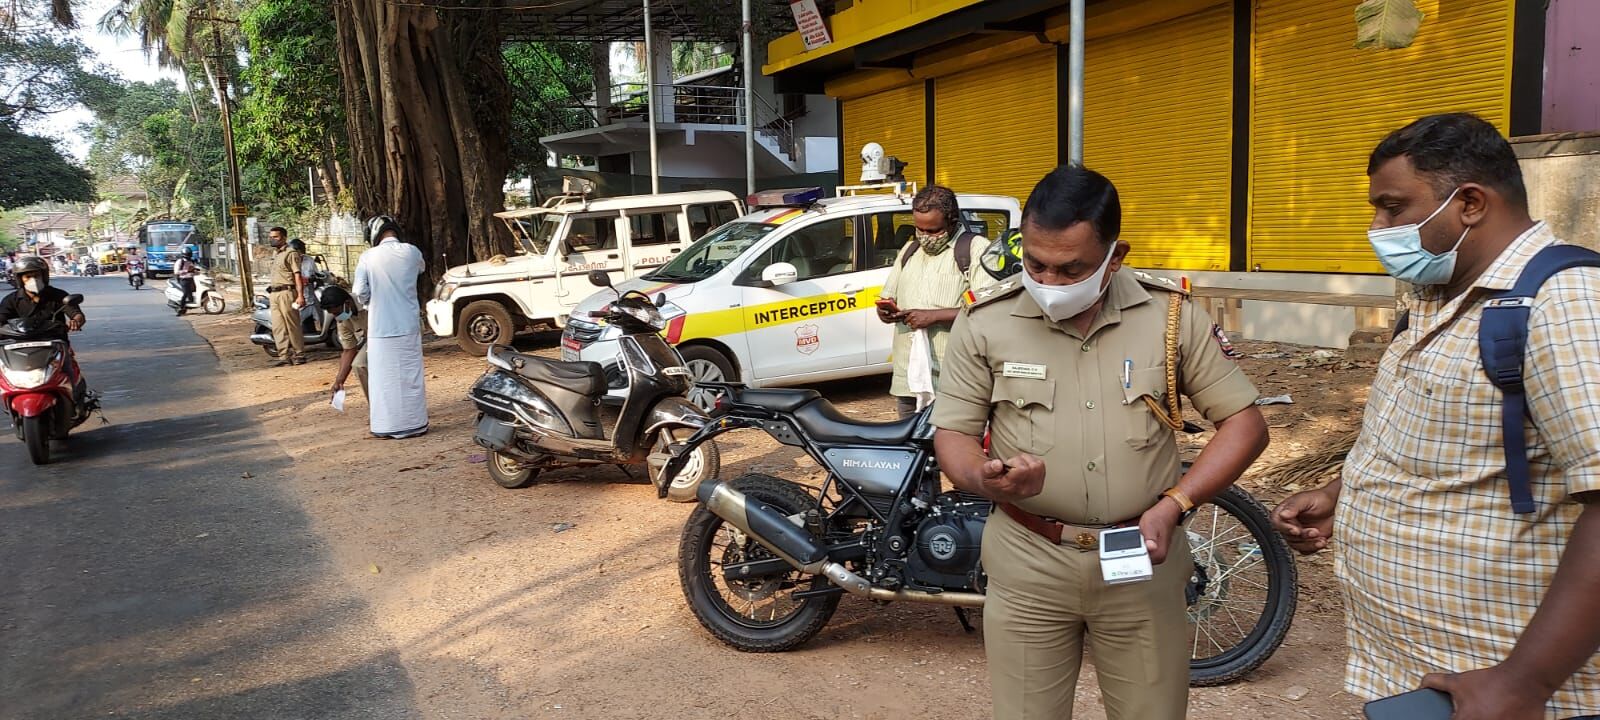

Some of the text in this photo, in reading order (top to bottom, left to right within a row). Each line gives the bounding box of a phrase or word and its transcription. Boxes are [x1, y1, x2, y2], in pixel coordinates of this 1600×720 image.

[642, 254, 675, 264] POLIC
[754, 297, 857, 325] INTERCEPTOR
[798, 336, 818, 346] MVD
[842, 459, 901, 470] HIMALAYAN
